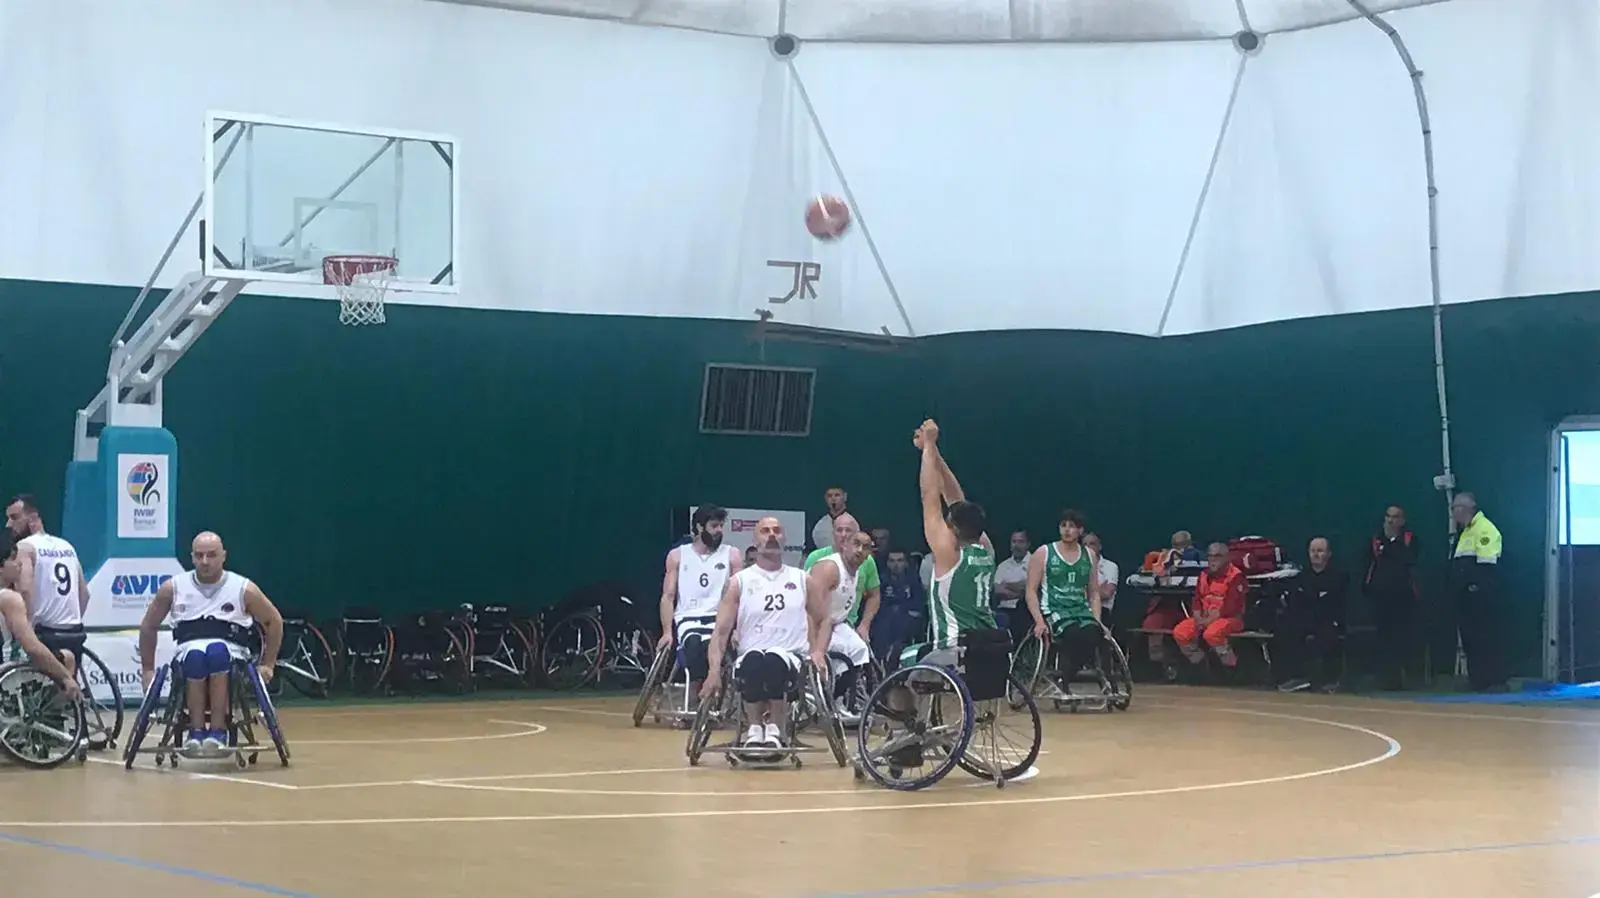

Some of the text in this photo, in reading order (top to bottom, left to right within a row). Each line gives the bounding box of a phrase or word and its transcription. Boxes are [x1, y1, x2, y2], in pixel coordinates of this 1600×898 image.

[767, 260, 820, 303] JR
[54, 563, 71, 596] 9
[699, 572, 709, 588] 6
[974, 571, 992, 608] 11
[764, 593, 785, 611] 23
